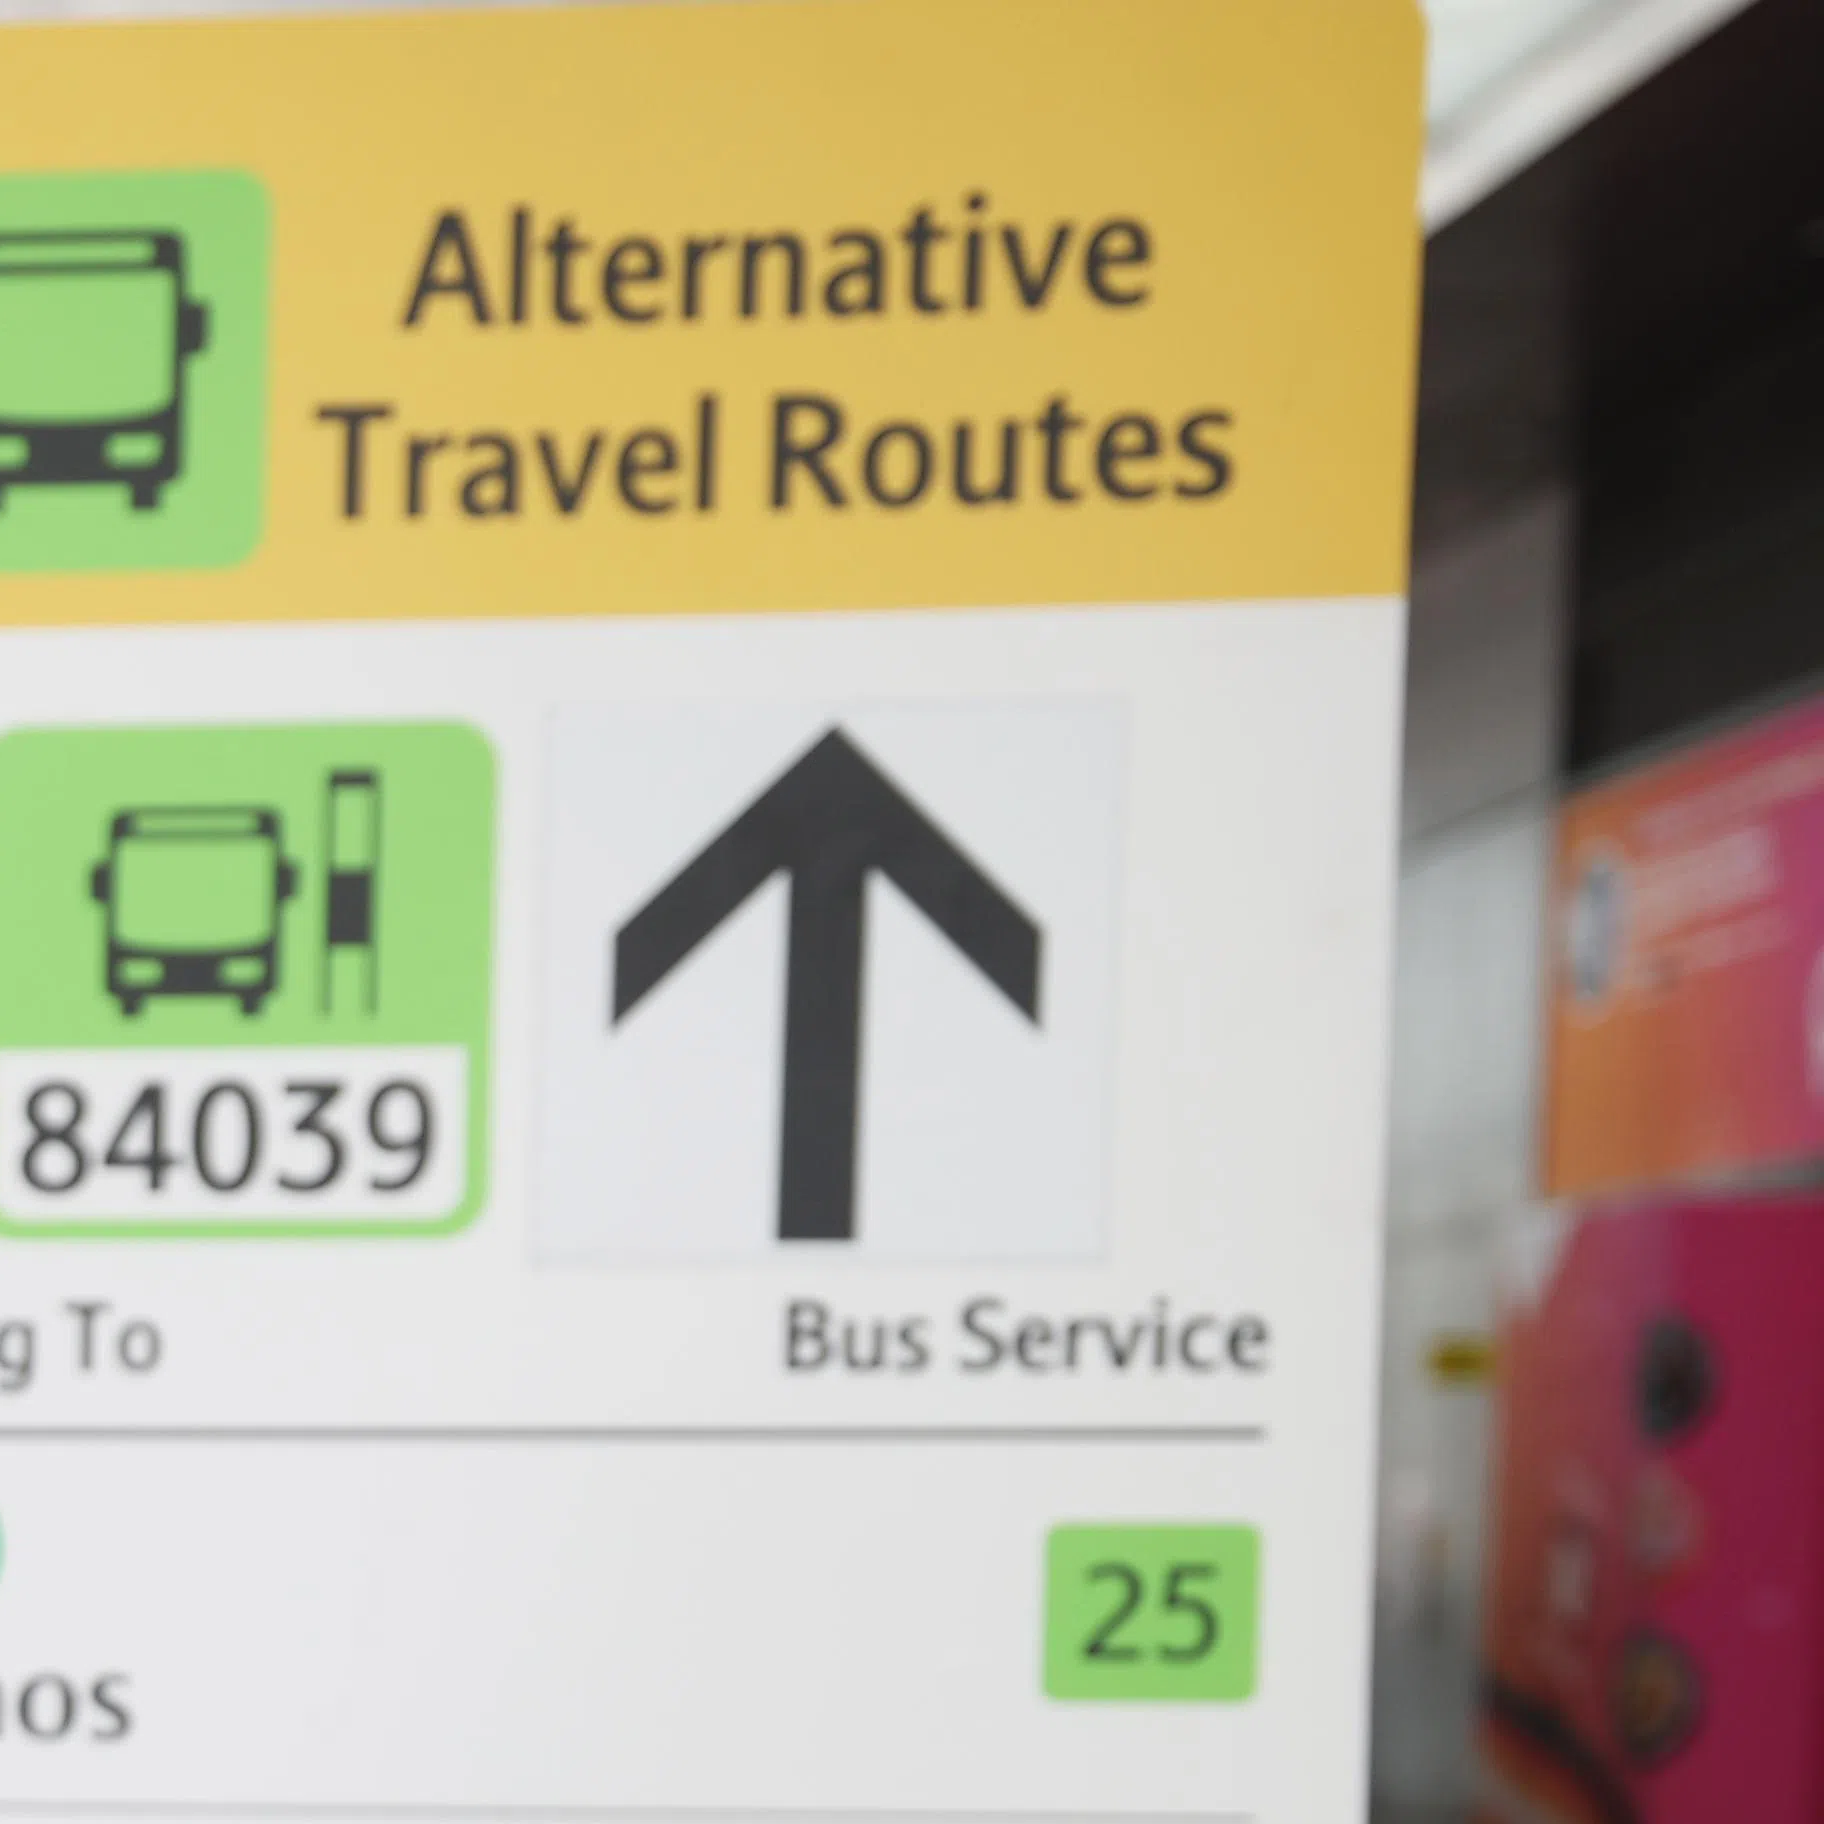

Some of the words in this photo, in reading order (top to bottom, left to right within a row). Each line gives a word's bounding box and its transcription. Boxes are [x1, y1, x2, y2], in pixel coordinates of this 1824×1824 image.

[400, 189, 1155, 330] Alternative
[314, 390, 721, 522] Travel
[767, 391, 1236, 513] Routes
[18, 1077, 437, 1196] 84039
[64, 1299, 165, 1375] To
[782, 1298, 933, 1376] Bus
[958, 1296, 1273, 1376] Service
[1078, 1560, 1223, 1667] 25
